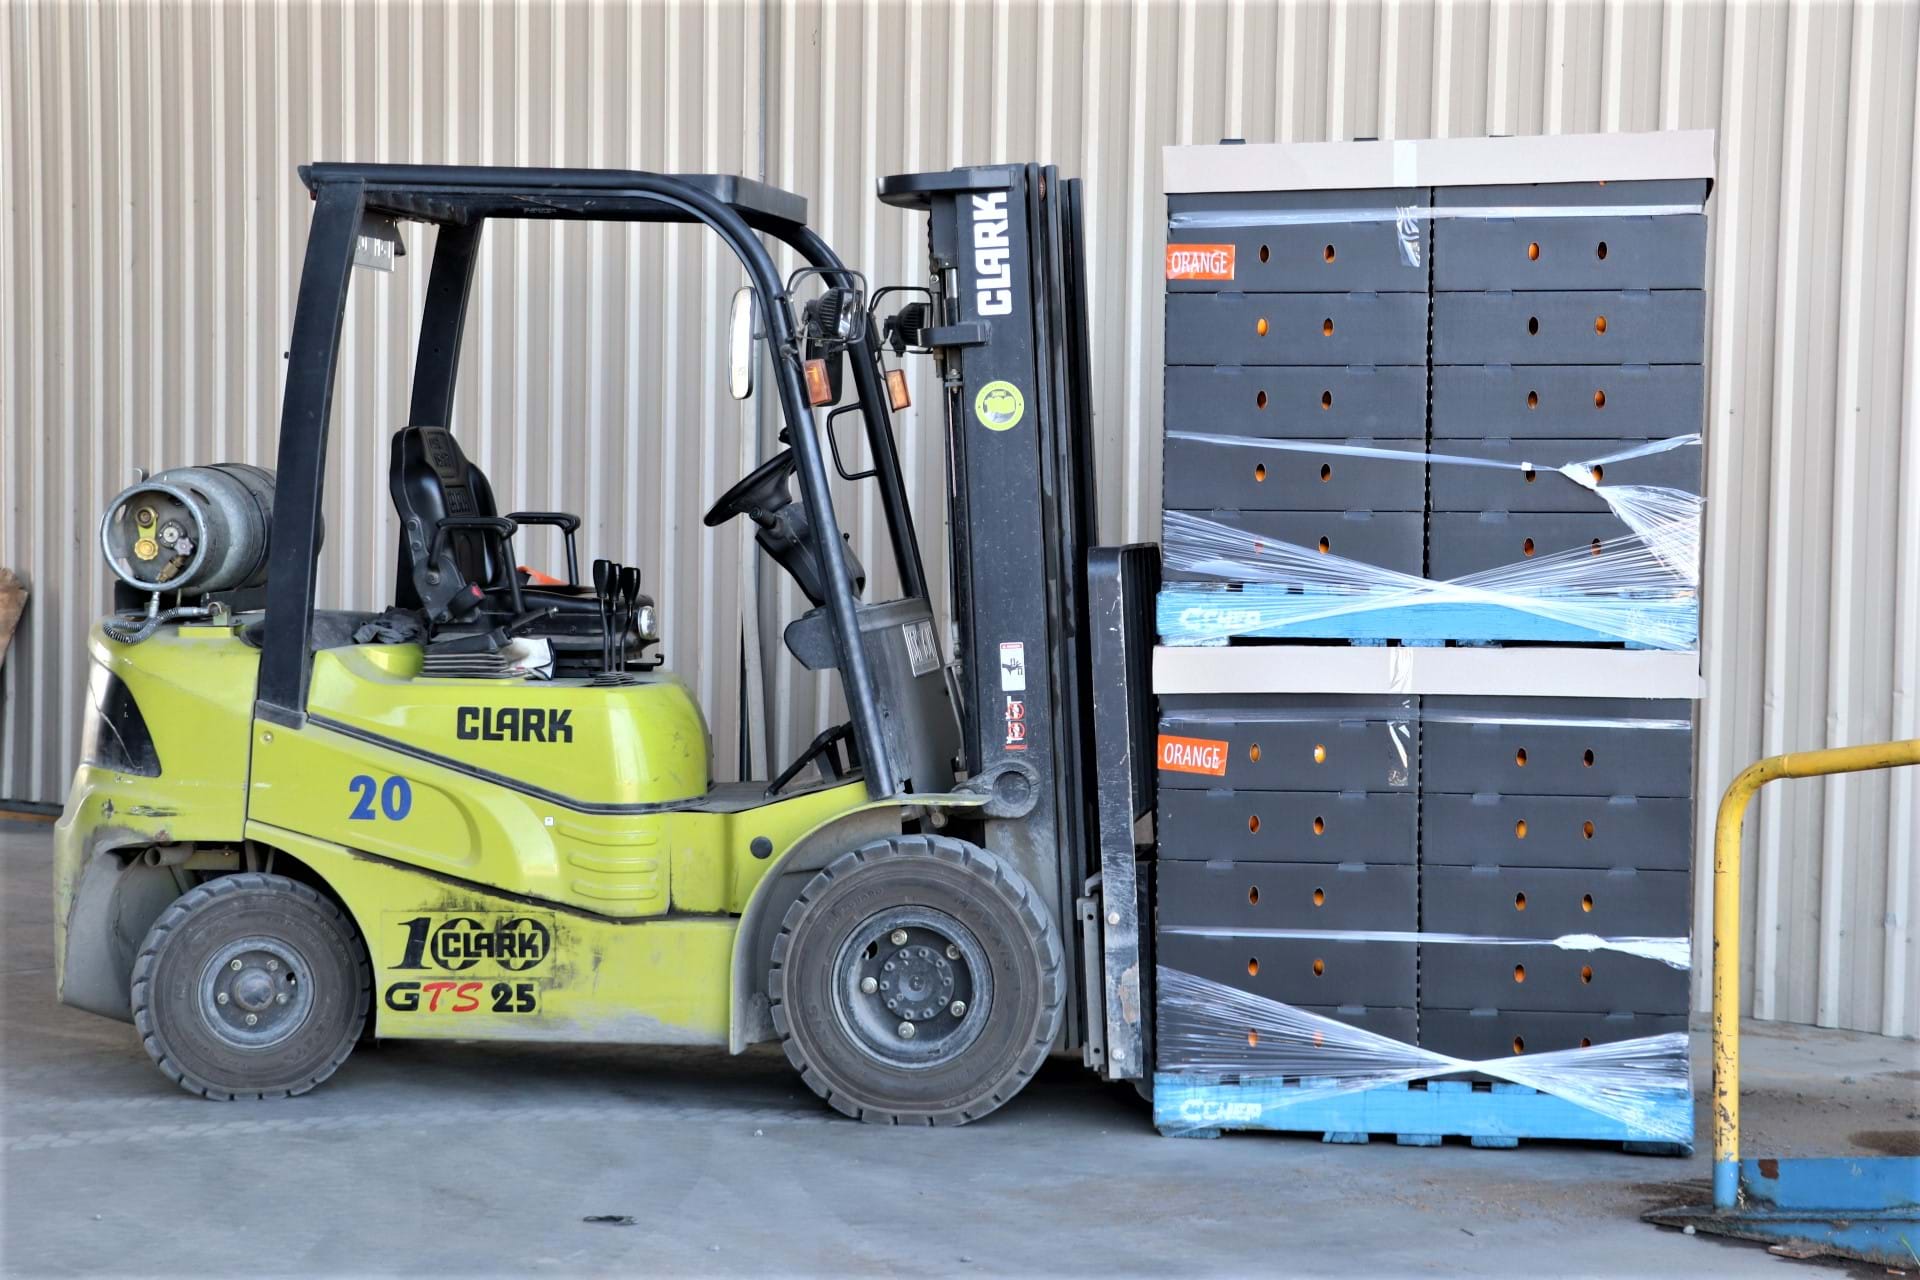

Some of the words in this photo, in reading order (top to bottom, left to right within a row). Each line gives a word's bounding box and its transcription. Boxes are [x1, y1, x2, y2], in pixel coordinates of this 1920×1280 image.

[972, 192, 1012, 316] CLARK
[1171, 251, 1228, 274] ORANGE
[457, 706, 573, 743] CLARK
[1163, 742, 1221, 769] ORANGE
[348, 775, 412, 821] 20
[442, 932, 539, 958] CLARK
[385, 981, 483, 1012] GTS
[491, 982, 537, 1013] 25
